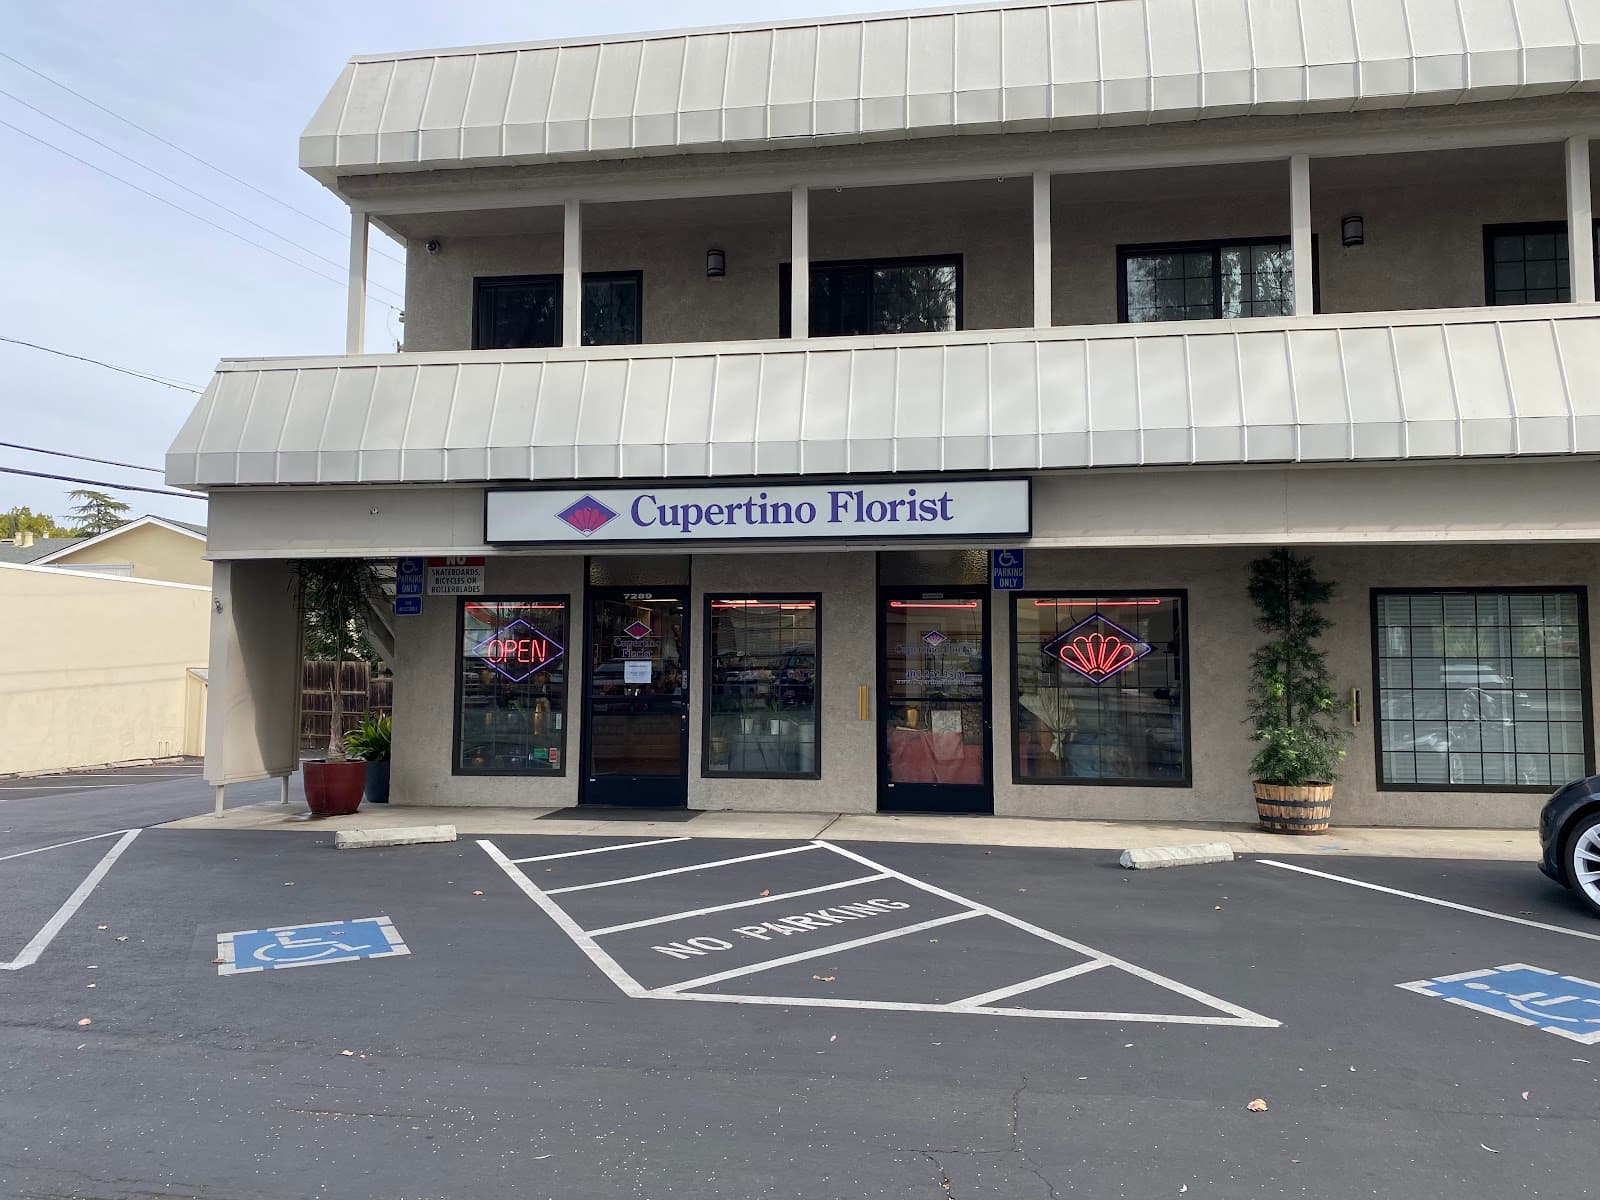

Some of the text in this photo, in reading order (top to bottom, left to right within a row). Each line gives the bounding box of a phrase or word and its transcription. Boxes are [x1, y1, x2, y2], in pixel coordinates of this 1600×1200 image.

[631, 488, 955, 533] Cupertino Florist
[446, 556, 466, 565] NO
[994, 567, 1023, 577] PARKING
[397, 574, 423, 584] PARKING
[435, 576, 477, 585] BICYCLES OR
[999, 577, 1018, 588] ONLY
[401, 584, 418, 593] ONLY
[431, 585, 481, 593] ROLLERBLADES
[487, 639, 546, 663] OPEN
[650, 898, 911, 960] NO PARKING
